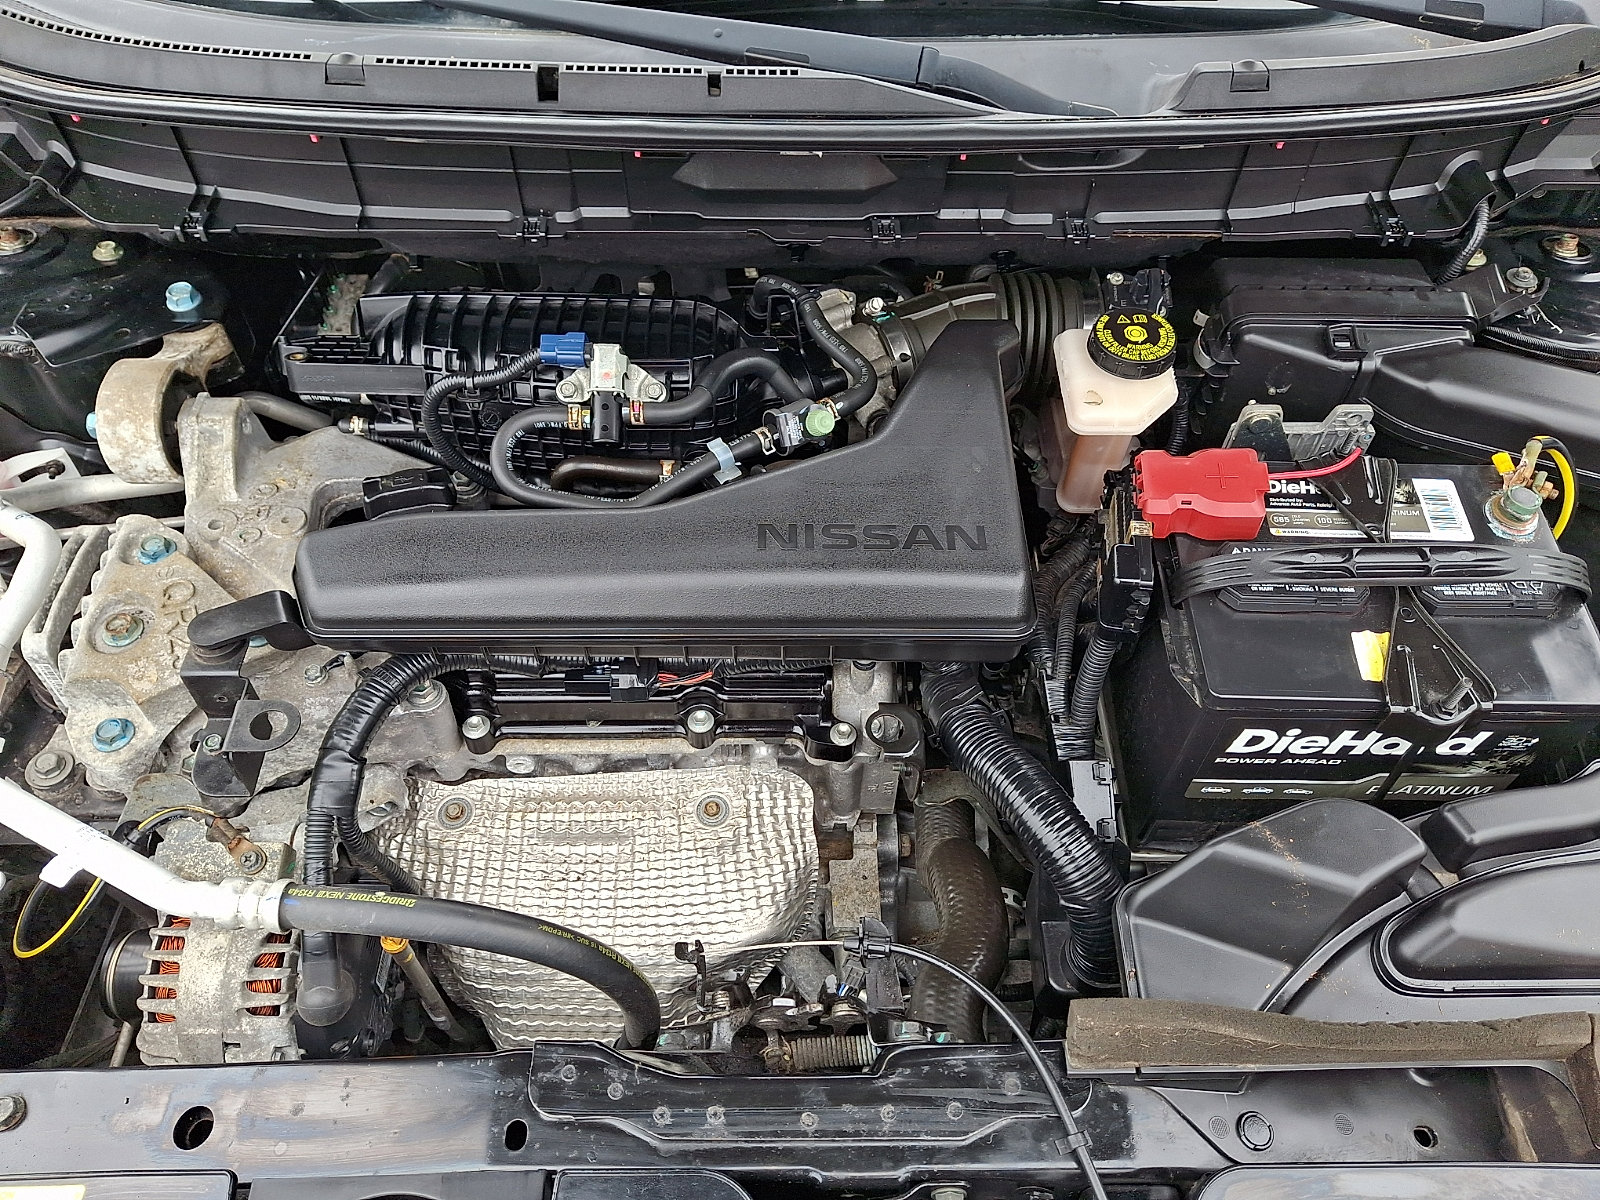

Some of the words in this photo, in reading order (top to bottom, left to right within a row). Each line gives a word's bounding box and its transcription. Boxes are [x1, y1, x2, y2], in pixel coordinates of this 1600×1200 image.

[757, 524, 987, 550] NISSAN
[1225, 728, 1494, 756] DieHad
[346, 893, 416, 907] BRIDGESTONE
